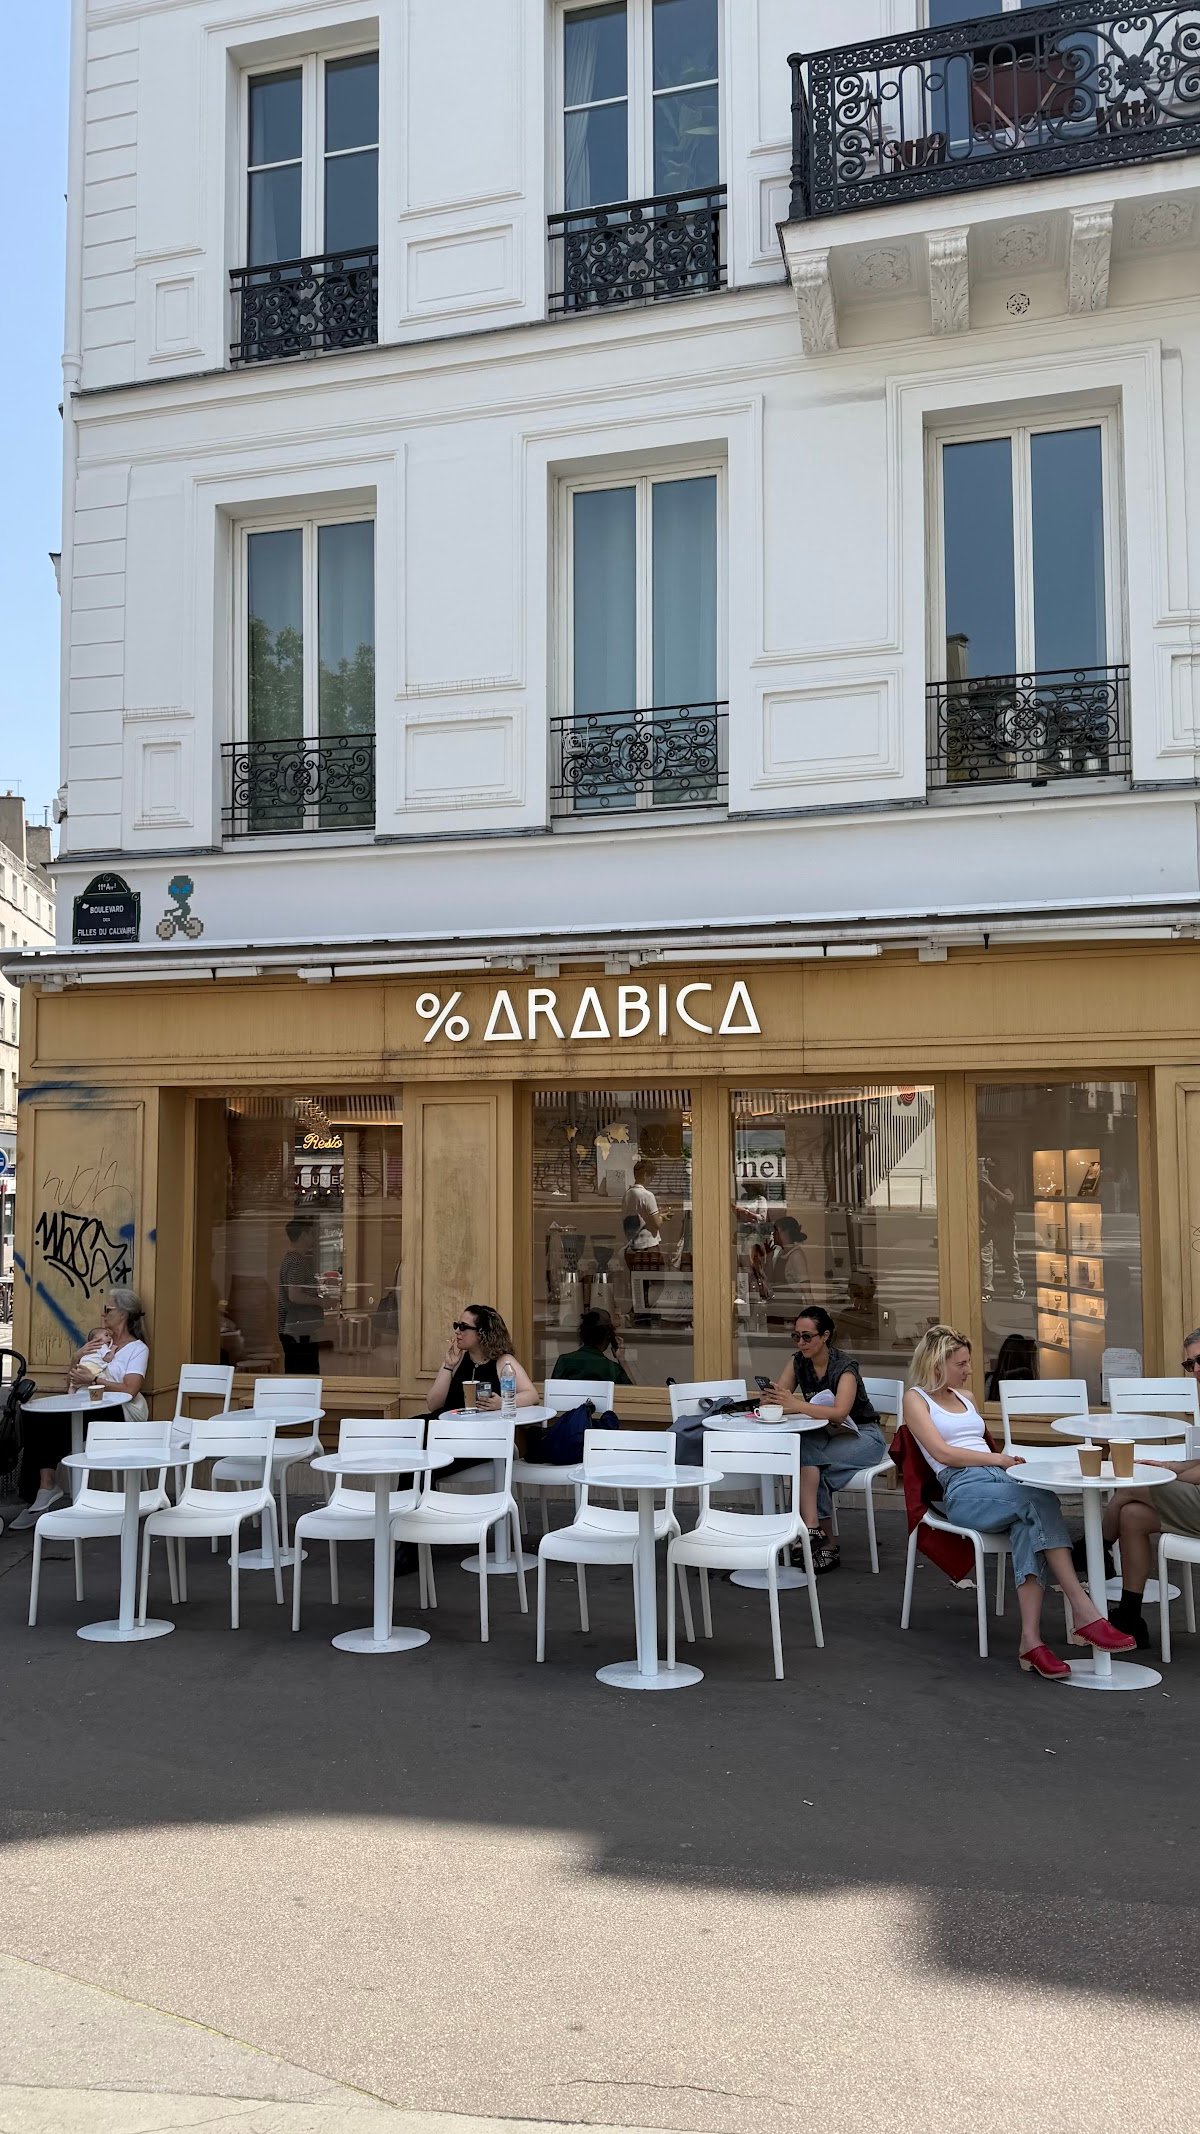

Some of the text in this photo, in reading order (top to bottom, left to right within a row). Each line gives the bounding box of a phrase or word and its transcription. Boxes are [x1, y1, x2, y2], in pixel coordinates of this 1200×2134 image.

[90, 905, 124, 914] BOULEVARD
[77, 926, 136, 937] FILLES DU CALVAIRE
[415, 980, 763, 1044] % ARABICA
[302, 1133, 343, 1149] Resto
